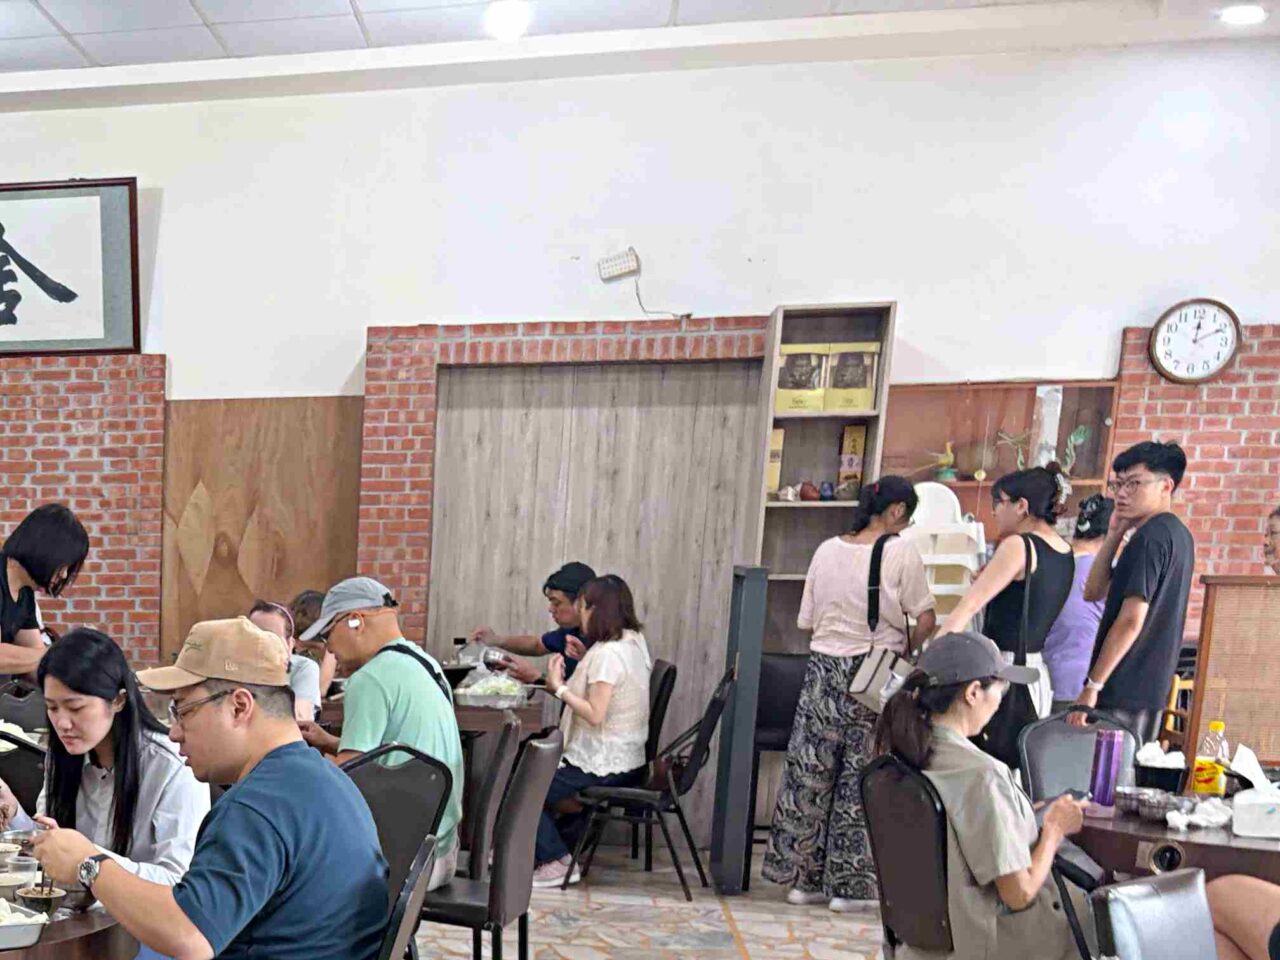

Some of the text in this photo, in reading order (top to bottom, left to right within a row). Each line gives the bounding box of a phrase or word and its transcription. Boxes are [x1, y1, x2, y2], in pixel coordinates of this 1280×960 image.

[1180, 312, 1188, 323] 11
[1193, 308, 1206, 320] 12
[1167, 321, 1178, 333] 10
[1163, 336, 1171, 347] 9
[1220, 336, 1228, 348] 3
[1164, 349, 1172, 361] 8
[1172, 360, 1181, 371] 7
[1186, 362, 1195, 374] 6
[1202, 360, 1210, 372] 5
